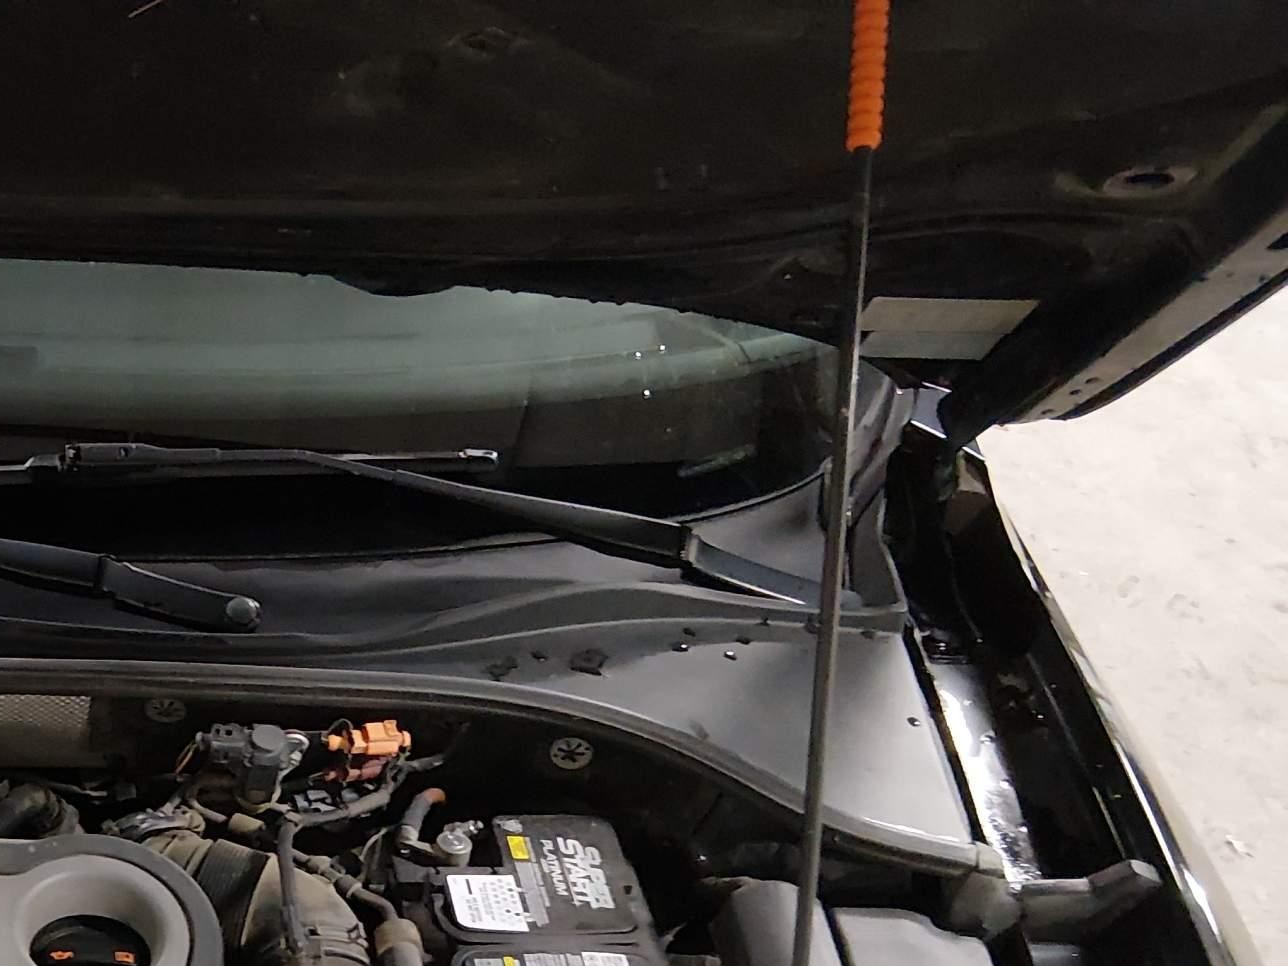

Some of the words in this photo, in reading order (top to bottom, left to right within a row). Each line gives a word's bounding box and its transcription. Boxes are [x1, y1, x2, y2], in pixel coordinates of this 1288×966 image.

[539, 839, 570, 897] PLATINUM
[556, 836, 594, 906] START
[583, 846, 616, 909] SUPER
